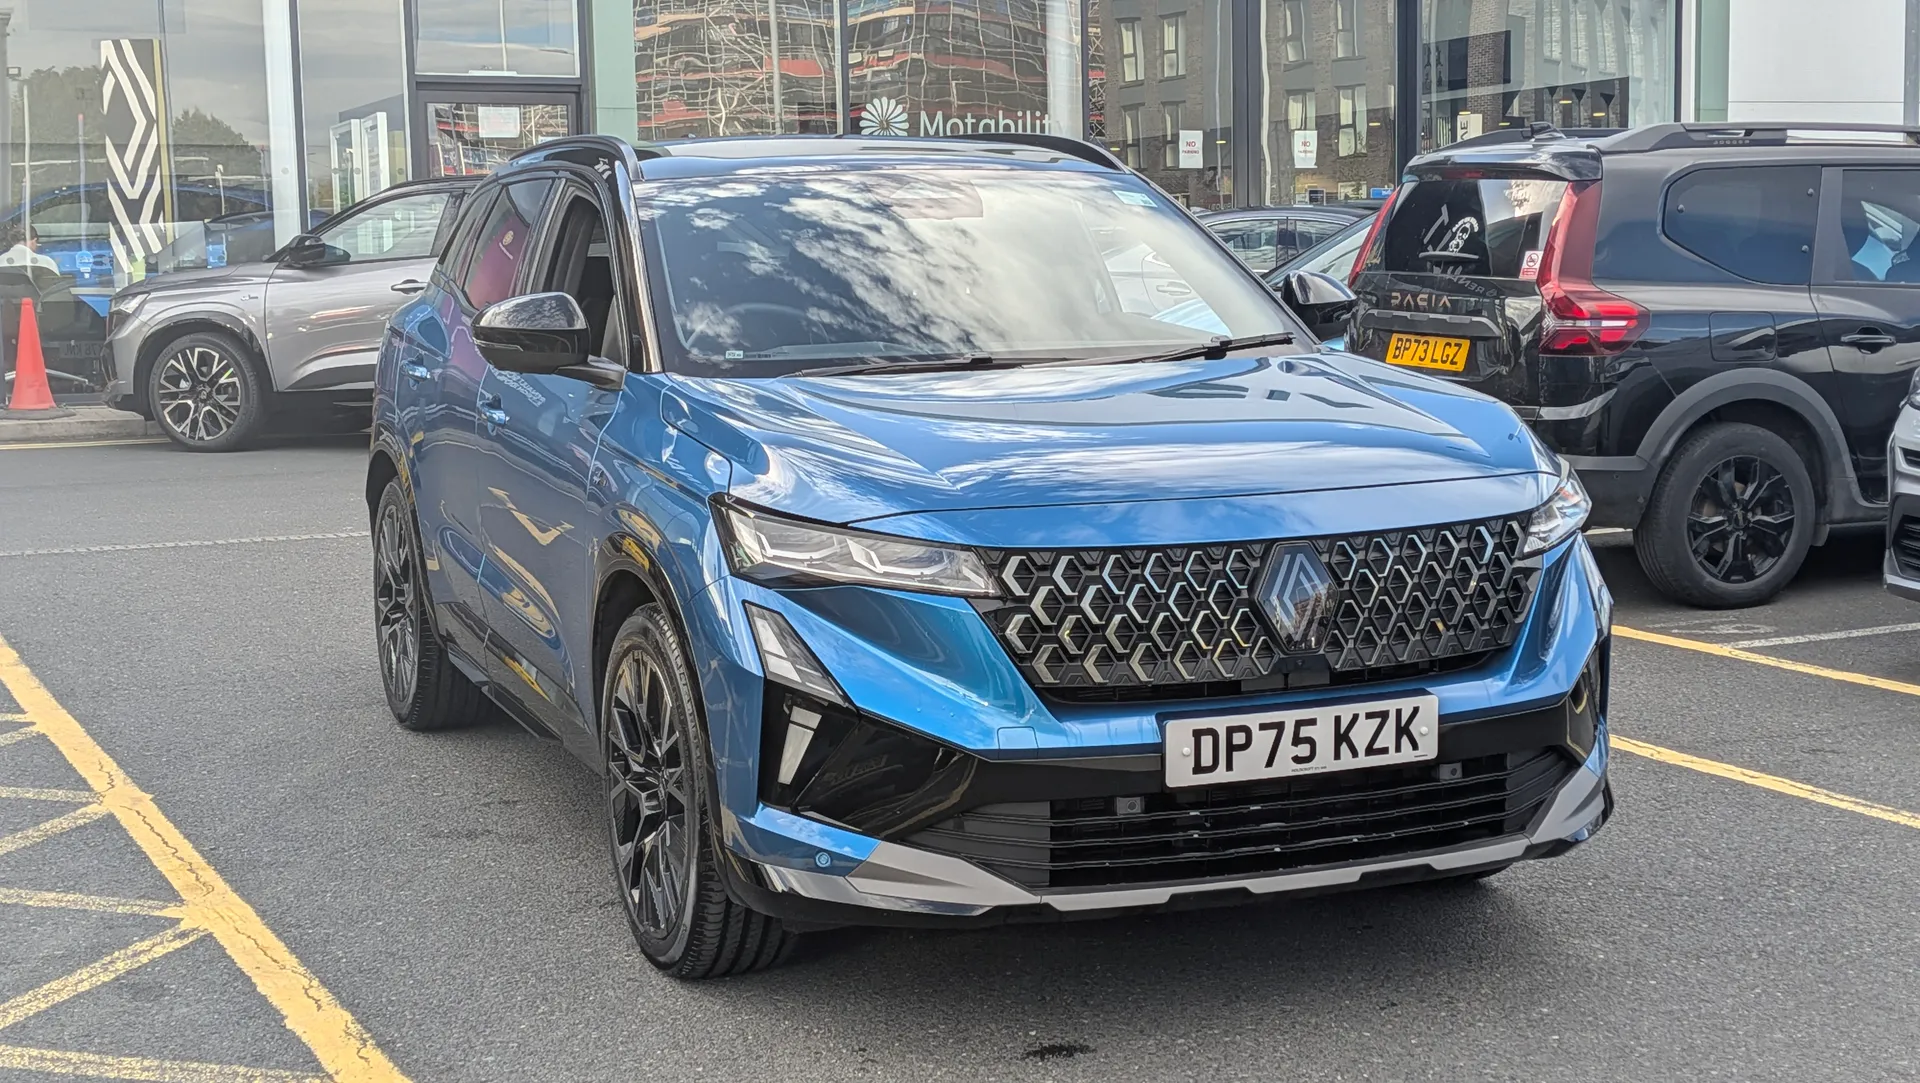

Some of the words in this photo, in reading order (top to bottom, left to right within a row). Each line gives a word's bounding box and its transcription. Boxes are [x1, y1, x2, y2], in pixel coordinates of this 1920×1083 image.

[1185, 140, 1197, 148] NO
[1301, 140, 1311, 148] NO
[1390, 291, 1452, 309] DACIA
[1392, 337, 1430, 362] BP73
[1430, 340, 1463, 366] LGZ
[1191, 717, 1318, 776] DP75
[1333, 705, 1420, 761] KZK
